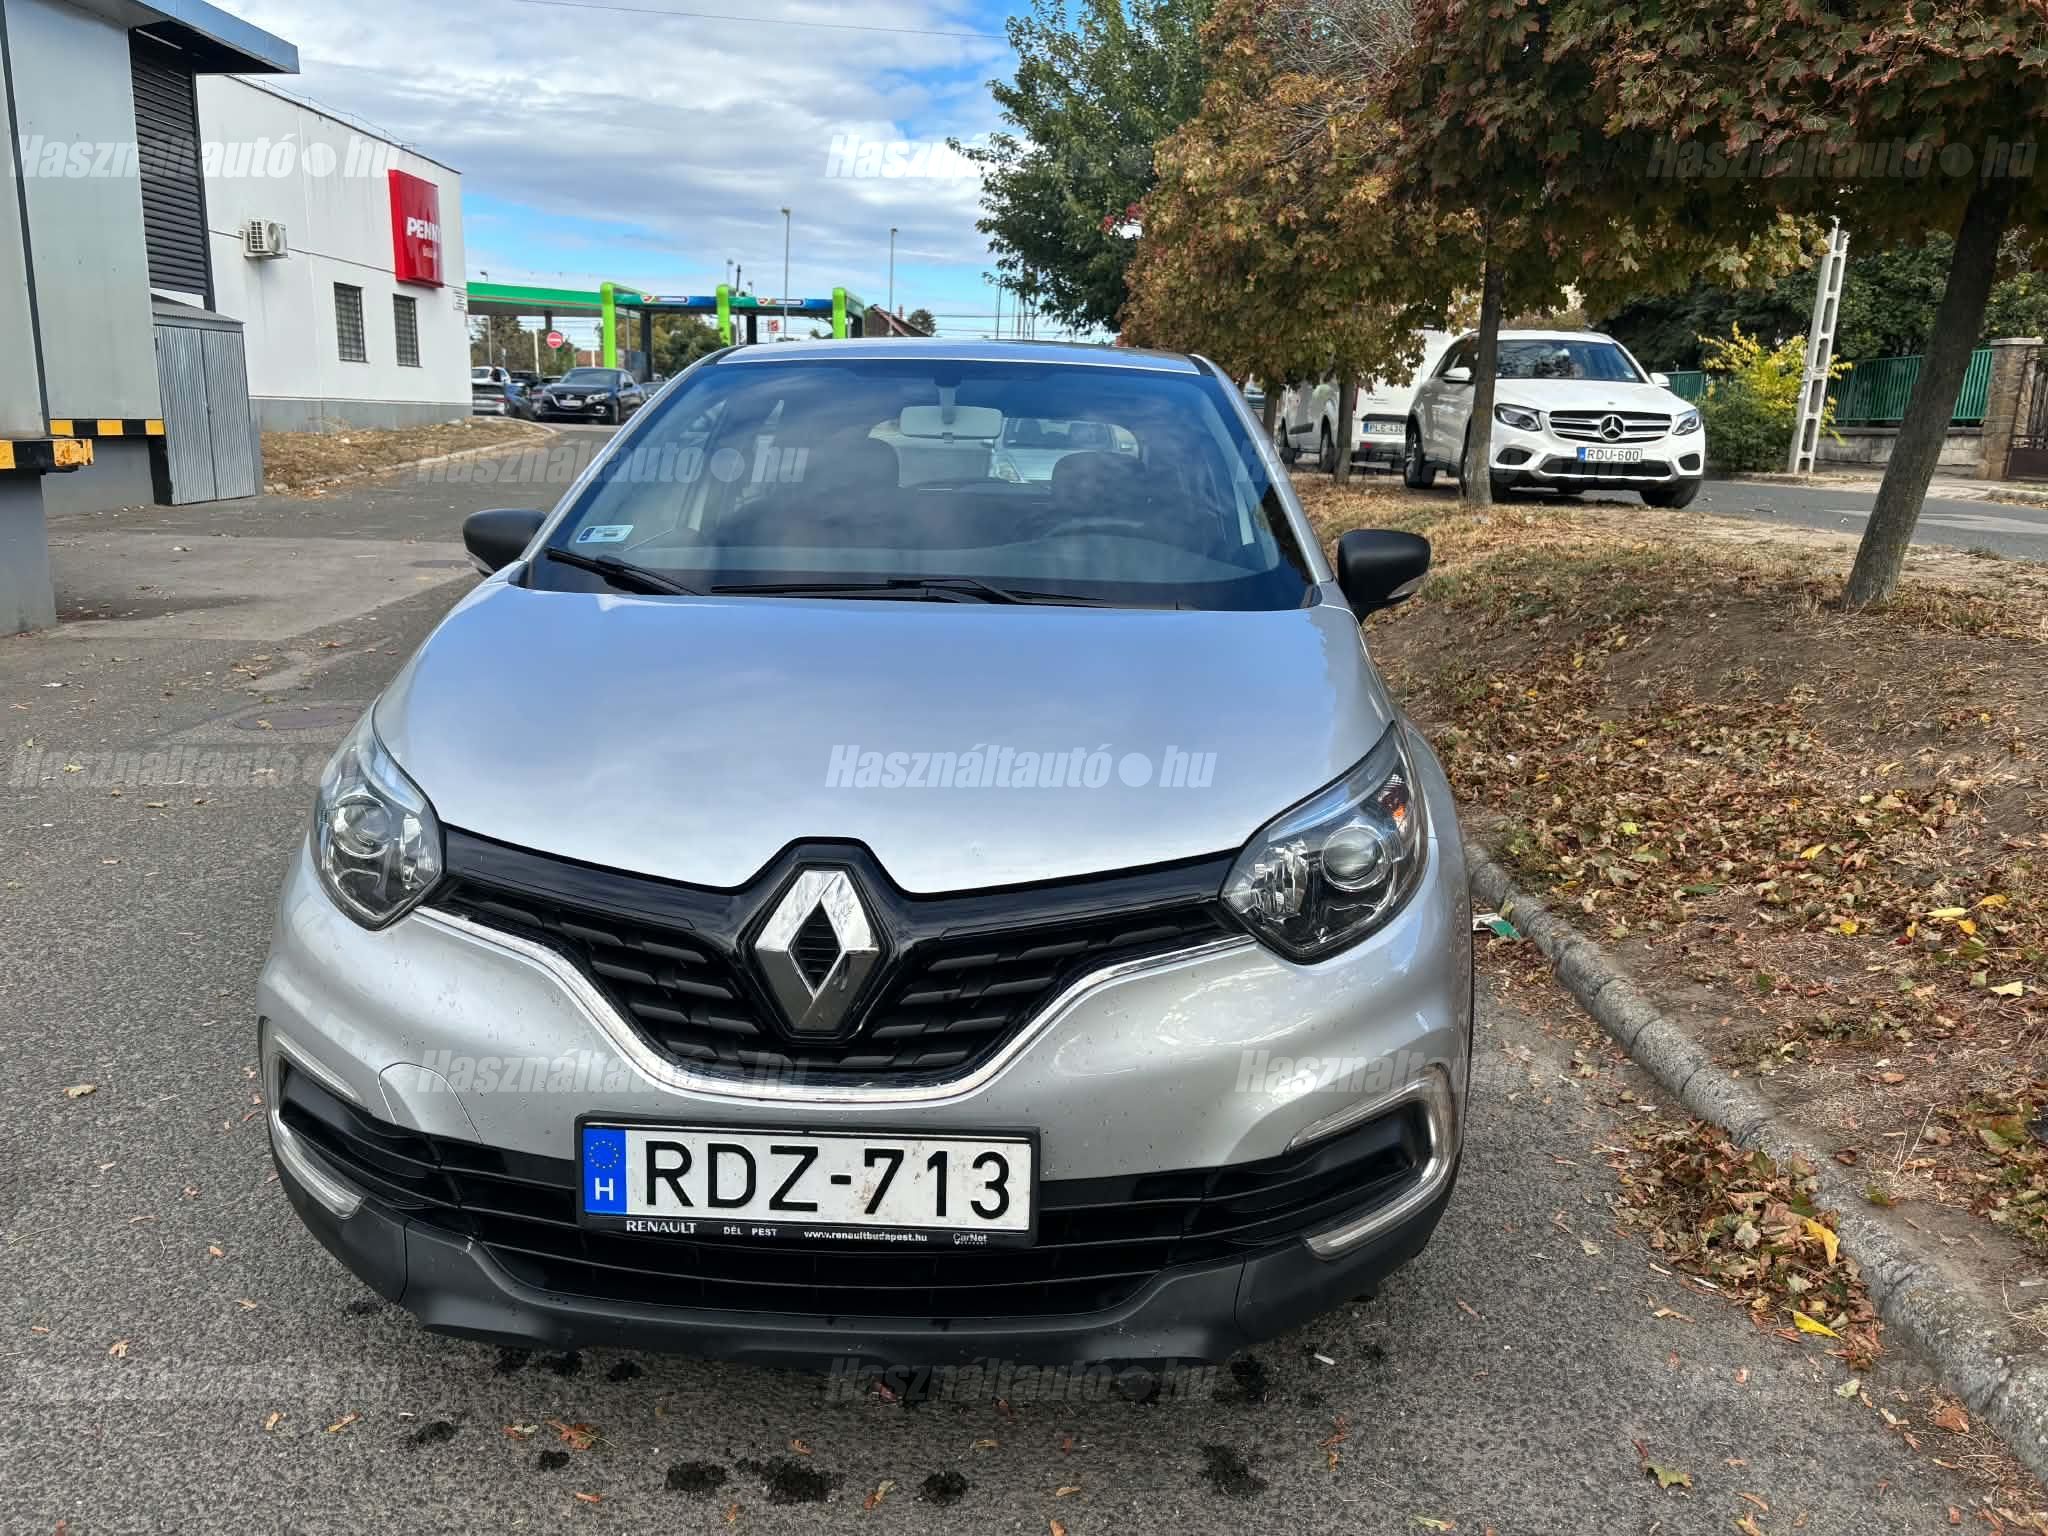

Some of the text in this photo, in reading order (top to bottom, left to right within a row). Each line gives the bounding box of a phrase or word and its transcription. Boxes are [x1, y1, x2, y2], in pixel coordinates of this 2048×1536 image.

[1588, 449, 1639, 461] RDU-600
[645, 1140, 1011, 1220] RDZ-713
[594, 1178, 614, 1201] H
[626, 1220, 697, 1235] RENAULT
[751, 1227, 778, 1237] PEST
